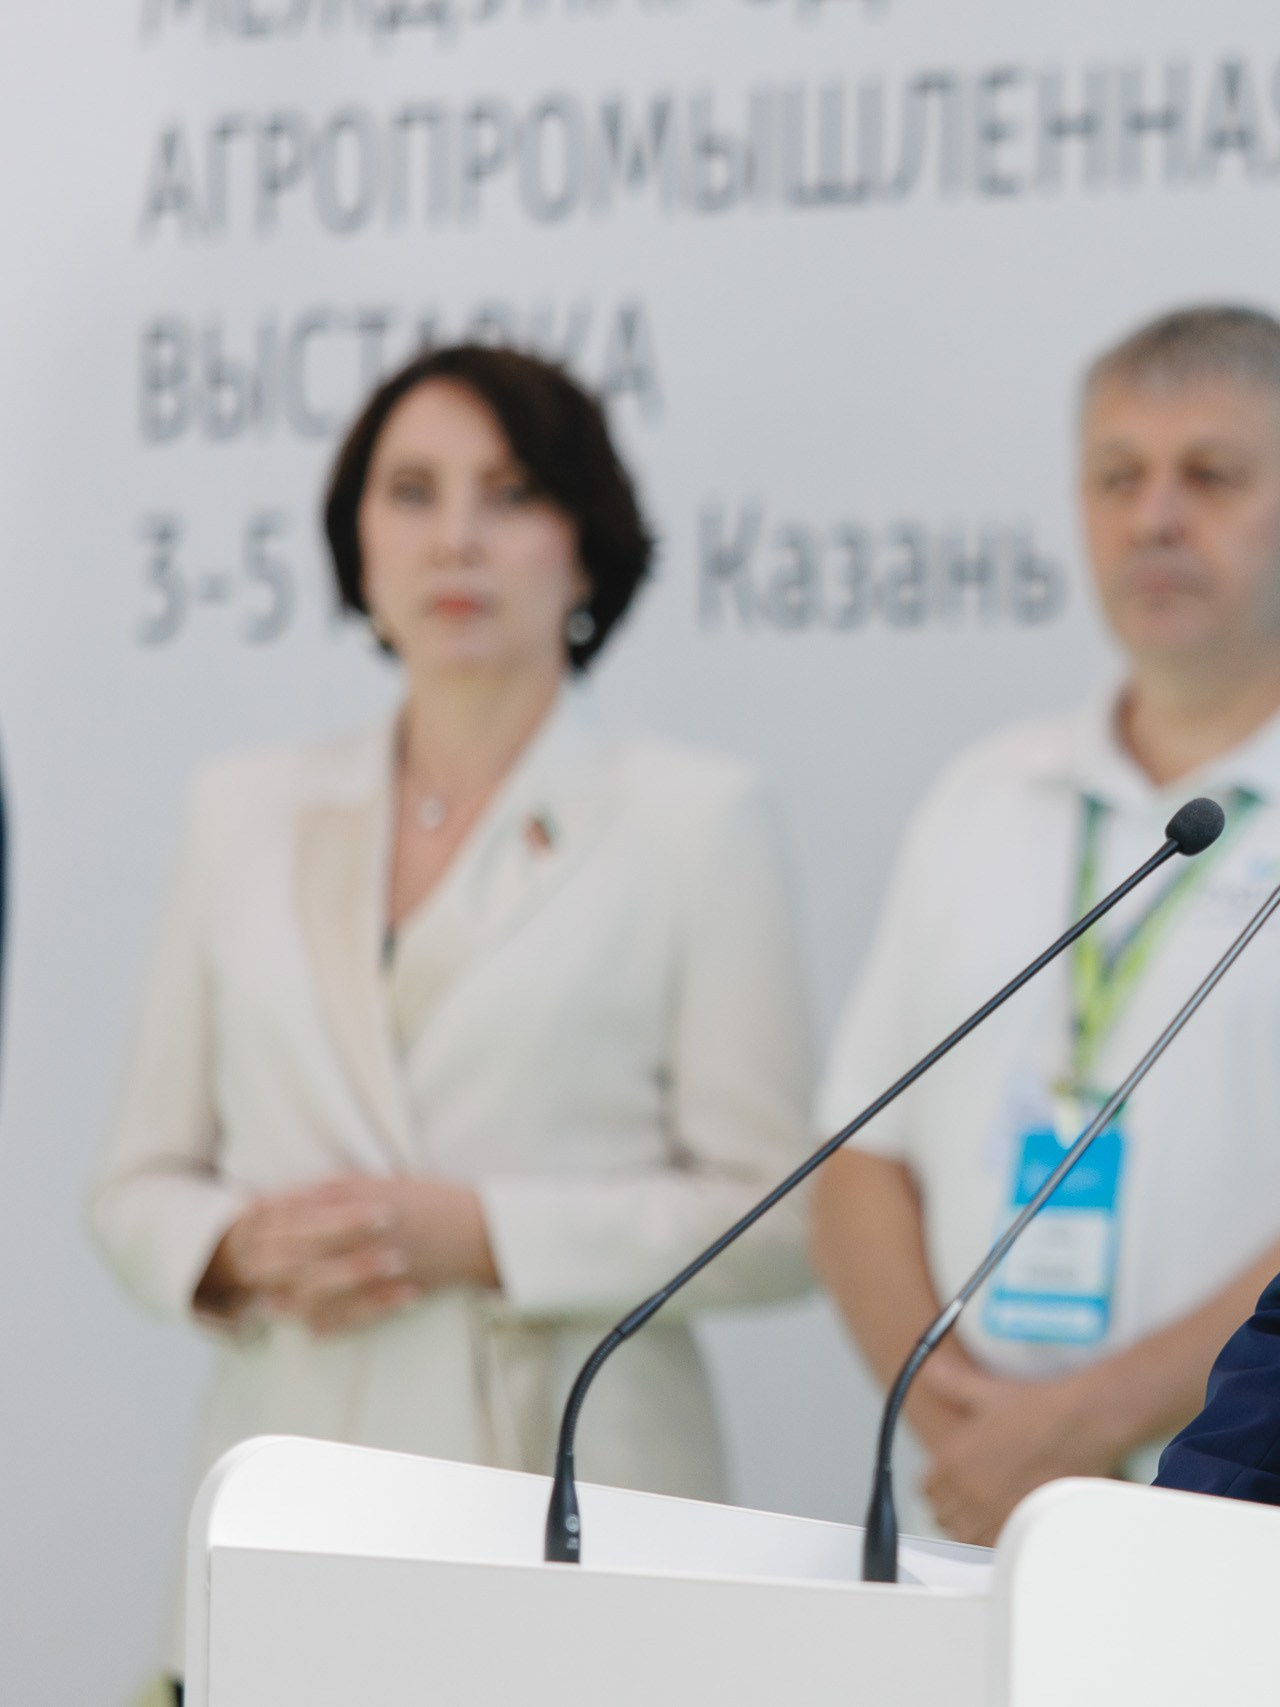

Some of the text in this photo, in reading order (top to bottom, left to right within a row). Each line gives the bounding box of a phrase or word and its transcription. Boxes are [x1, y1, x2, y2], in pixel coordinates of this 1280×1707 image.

[139, 302, 663, 444] ВЫСТА
[137, 500, 1070, 646] 3-5 Казань
